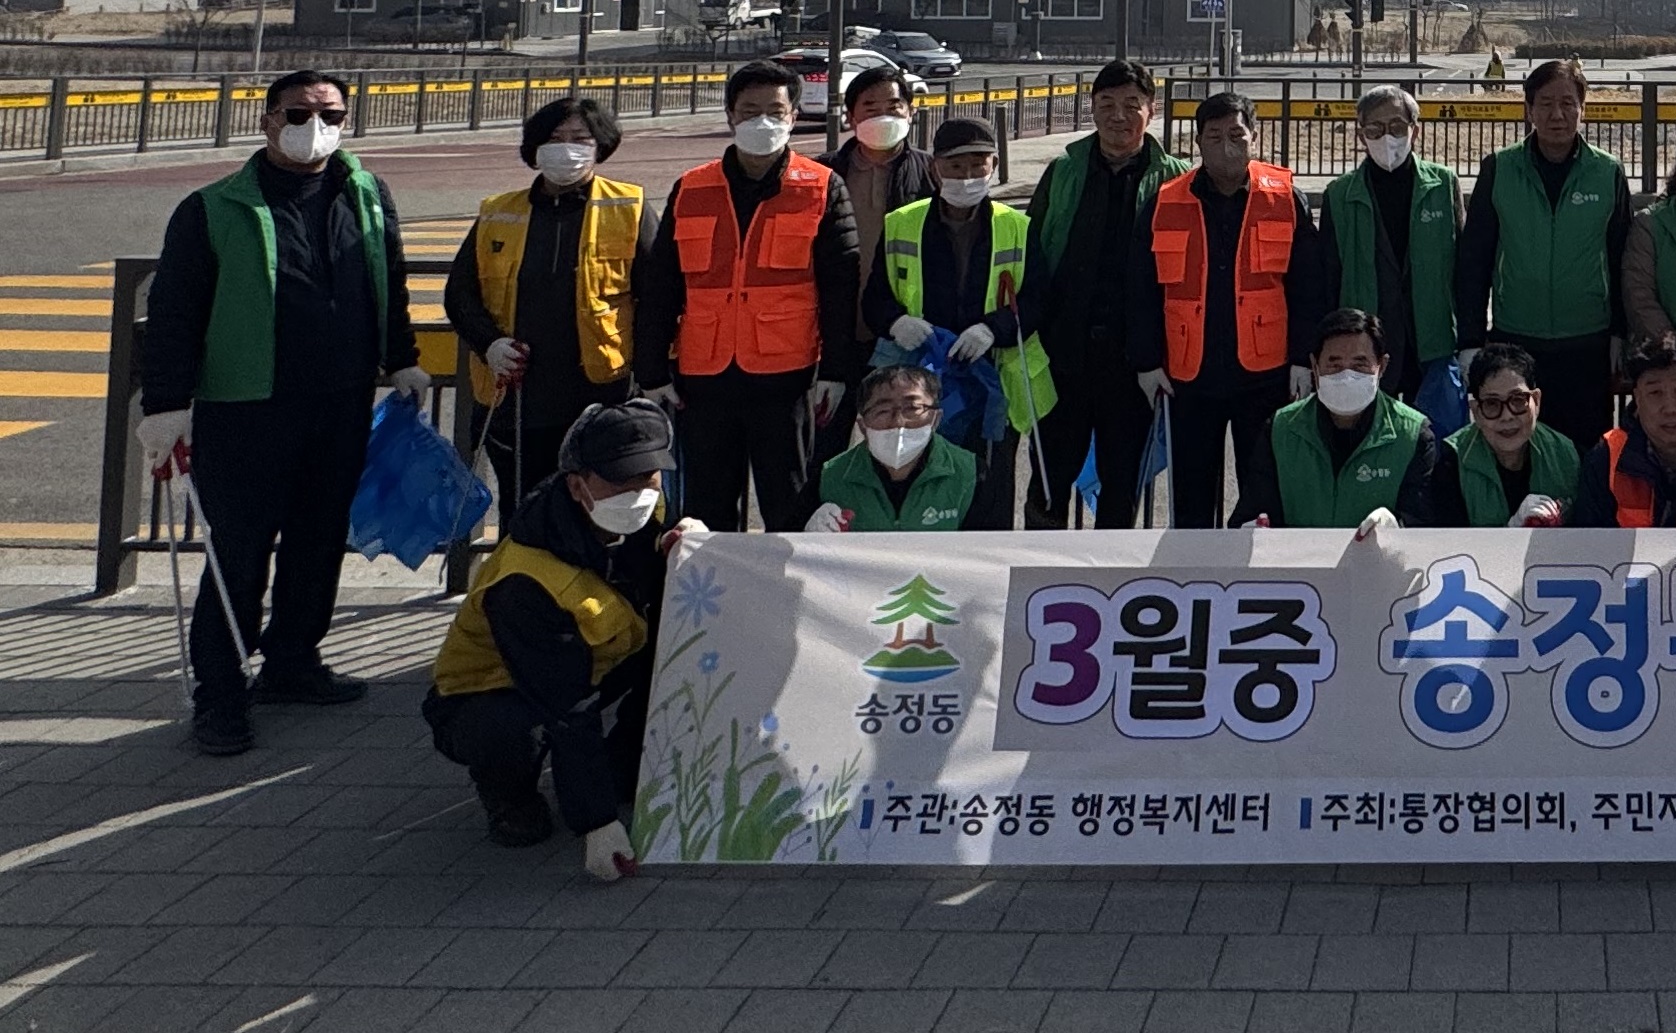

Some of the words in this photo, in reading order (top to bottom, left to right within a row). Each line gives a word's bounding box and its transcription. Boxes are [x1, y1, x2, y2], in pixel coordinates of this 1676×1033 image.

[1031, 594, 1320, 724] 3월중
[855, 693, 961, 734] 송정동
[883, 793, 1055, 836] 주관:송정동
[1072, 793, 1272, 836] 행정복지센터
[1321, 790, 1577, 835] 주최:통장협의회,
